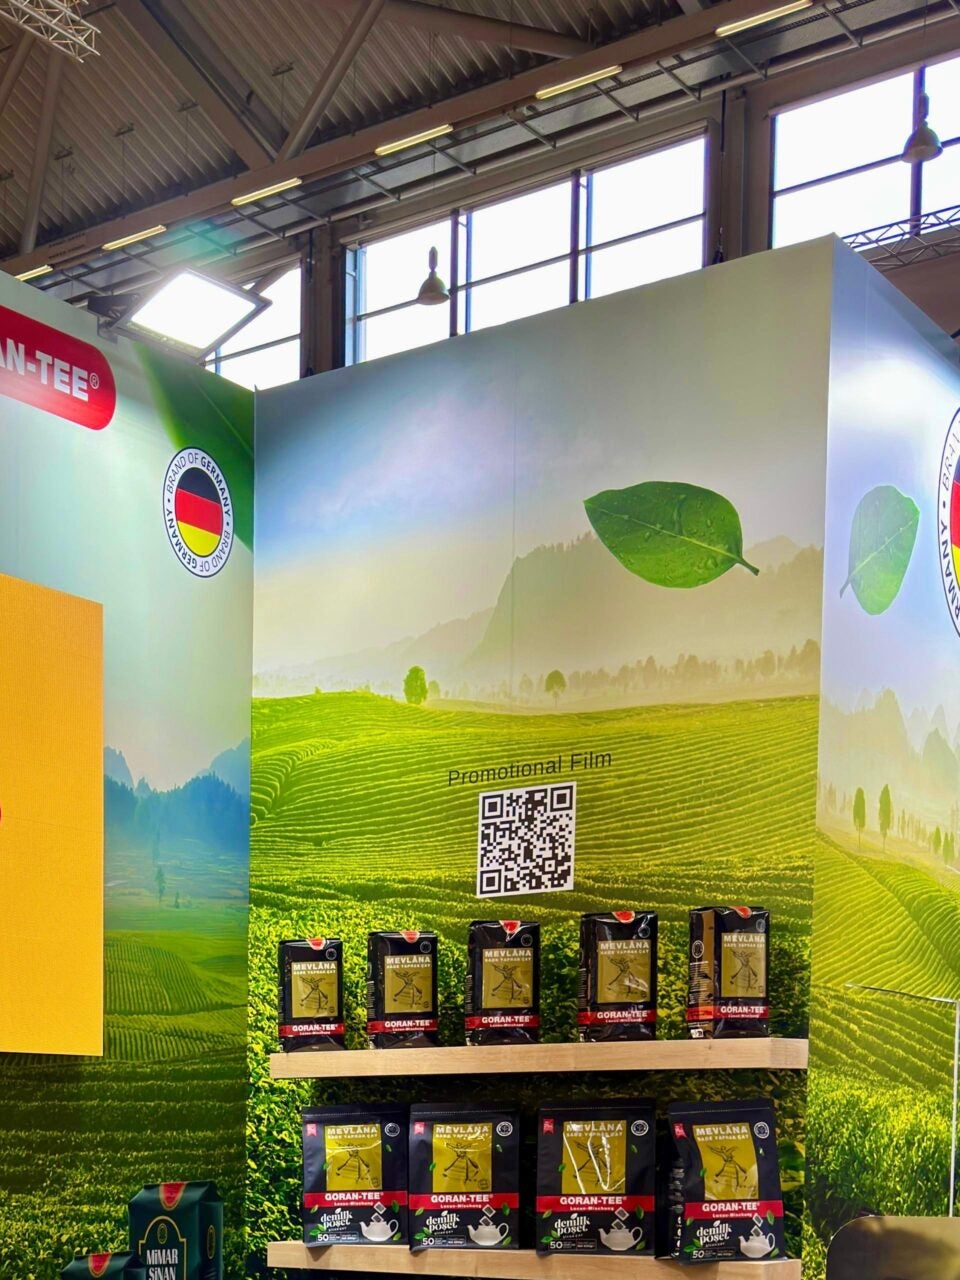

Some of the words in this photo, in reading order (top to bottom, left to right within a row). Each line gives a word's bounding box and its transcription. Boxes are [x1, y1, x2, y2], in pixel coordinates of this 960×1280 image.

[167, 456, 186, 494] BRAND
[188, 452, 199, 465] OF
[201, 456, 230, 517] GERMANY
[167, 509, 197, 569] GERMANY
[212, 531, 230, 568] BRAND
[200, 560, 210, 572] OF
[447, 756, 562, 787] Promotional
[570, 750, 613, 774] Film
[317, 1234, 329, 1242] 50
[422, 1237, 435, 1246] 50
[550, 1241, 563, 1250] 50
[692, 1250, 705, 1259] 50
